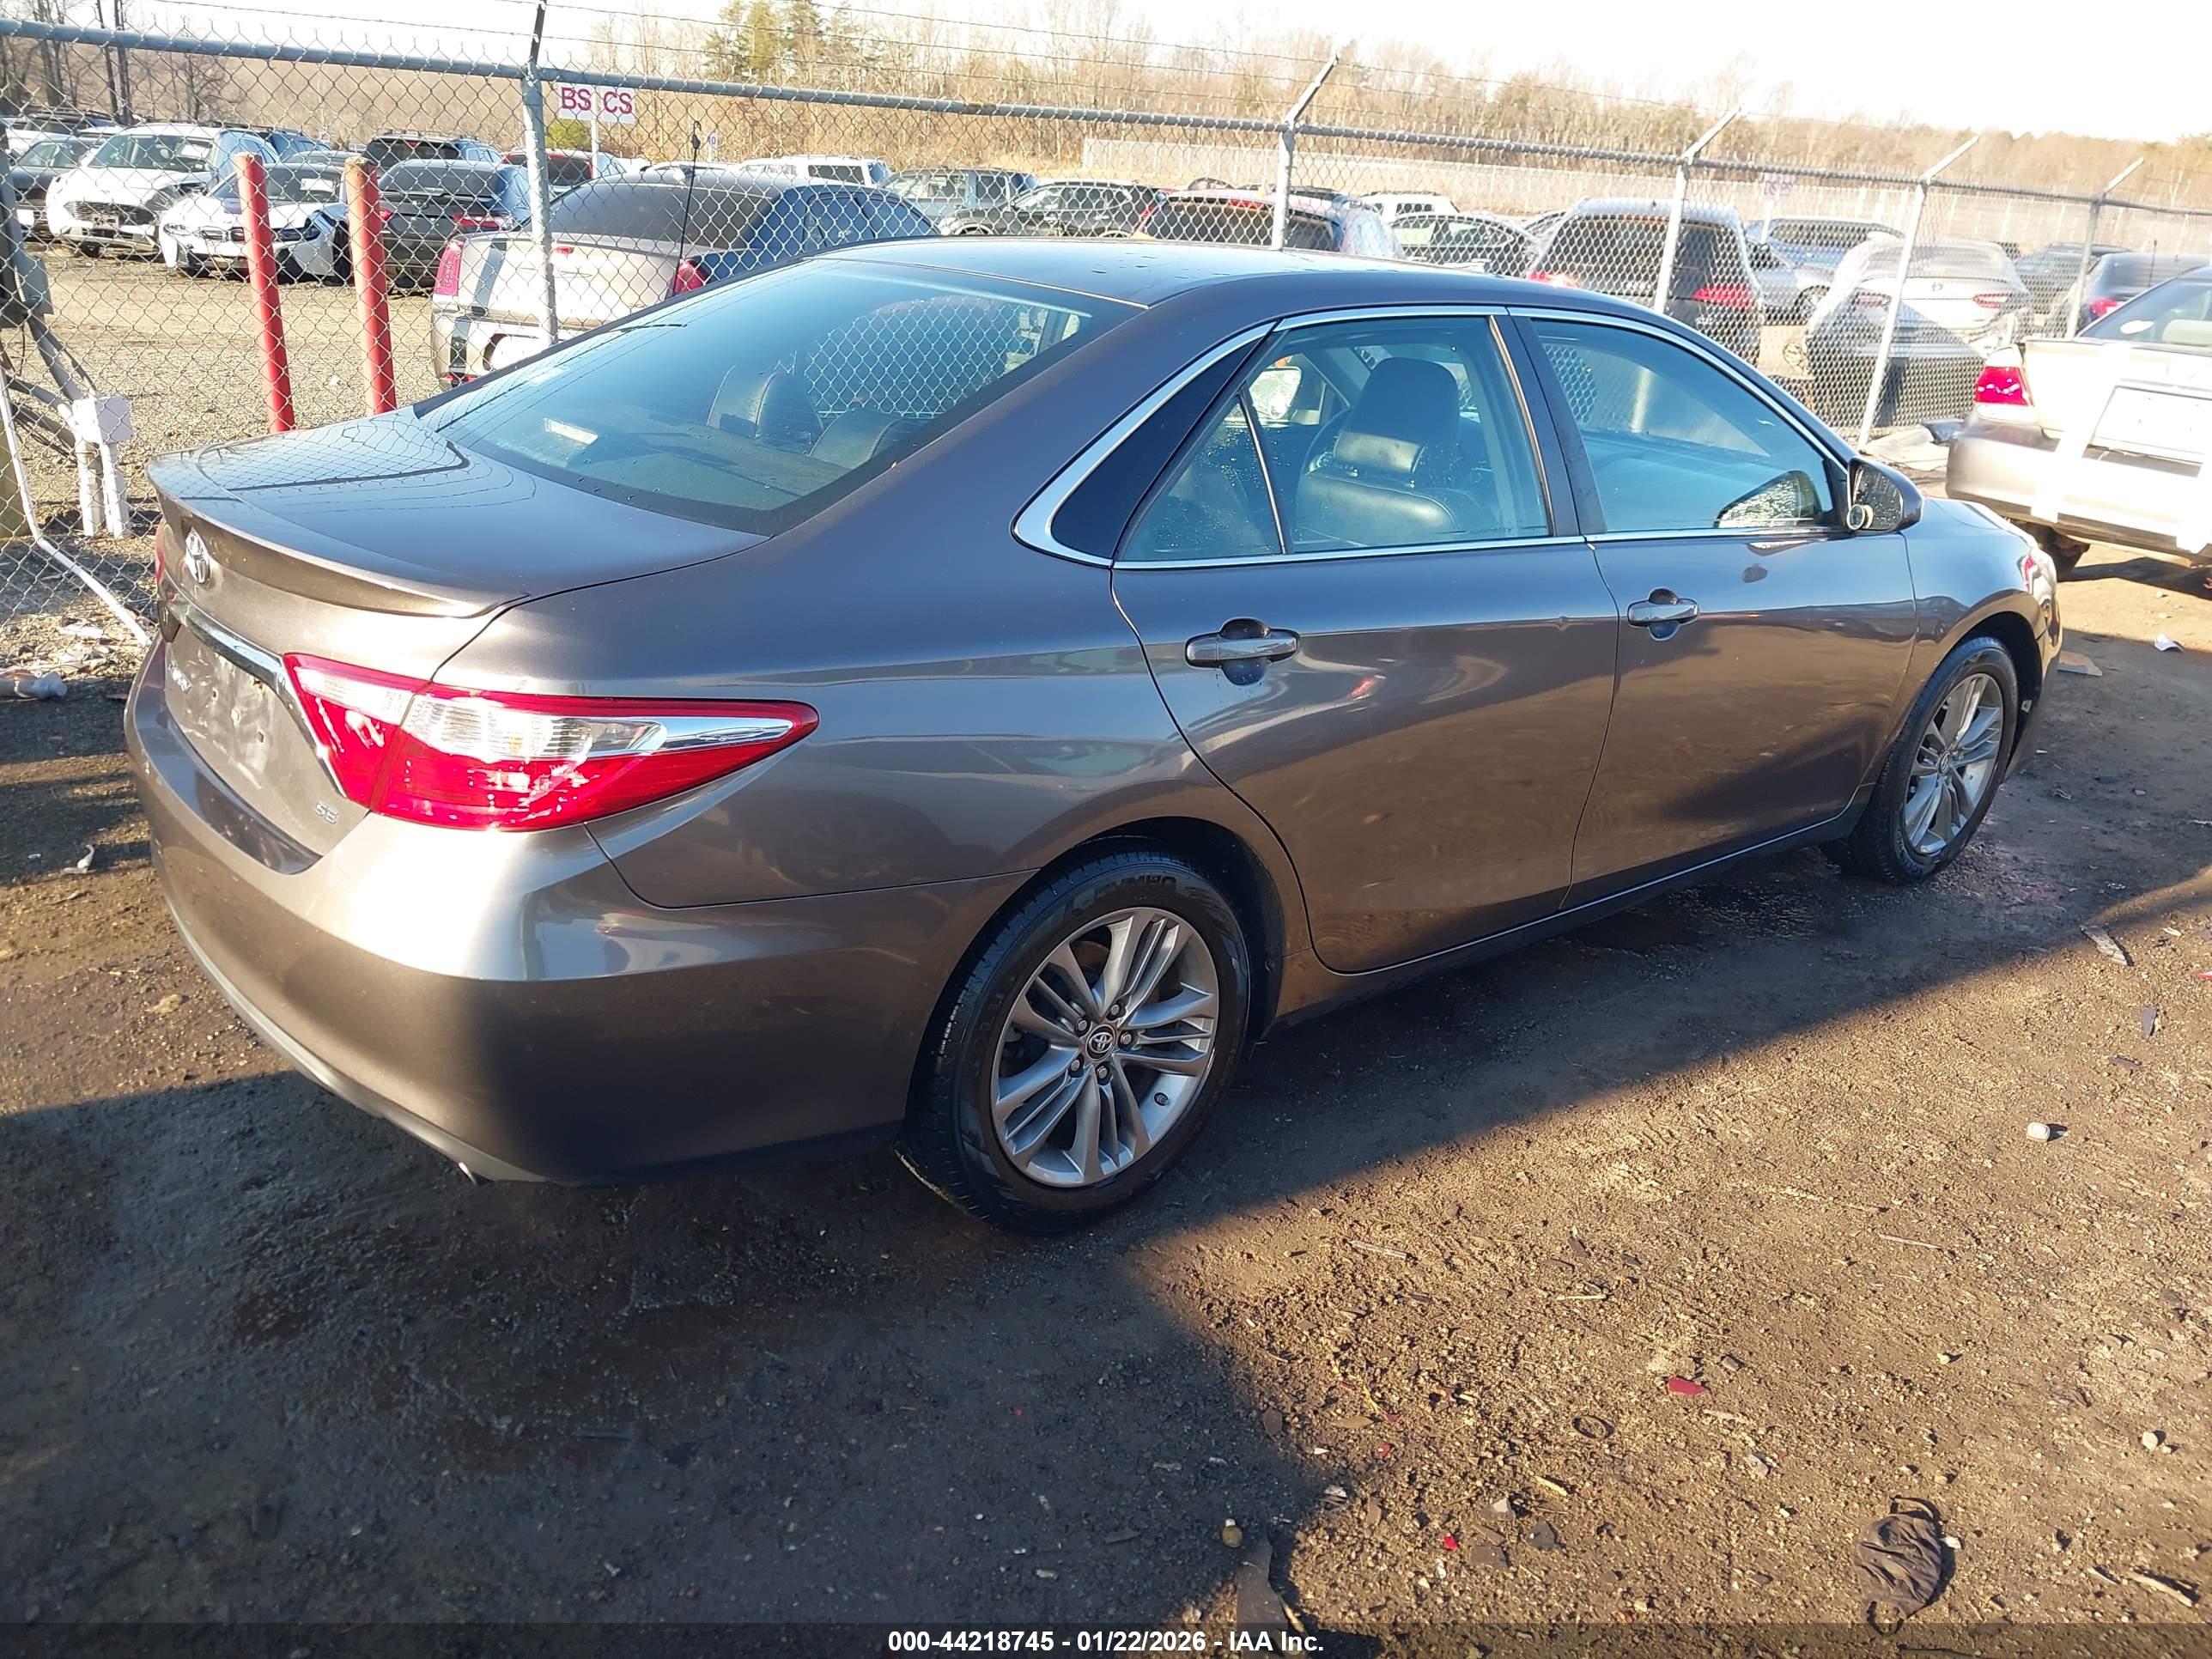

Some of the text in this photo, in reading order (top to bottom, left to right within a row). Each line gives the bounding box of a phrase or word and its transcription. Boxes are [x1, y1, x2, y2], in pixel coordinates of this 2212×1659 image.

[561, 87, 592, 111] BS
[603, 91, 633, 114] CS
[315, 801, 338, 824] SE
